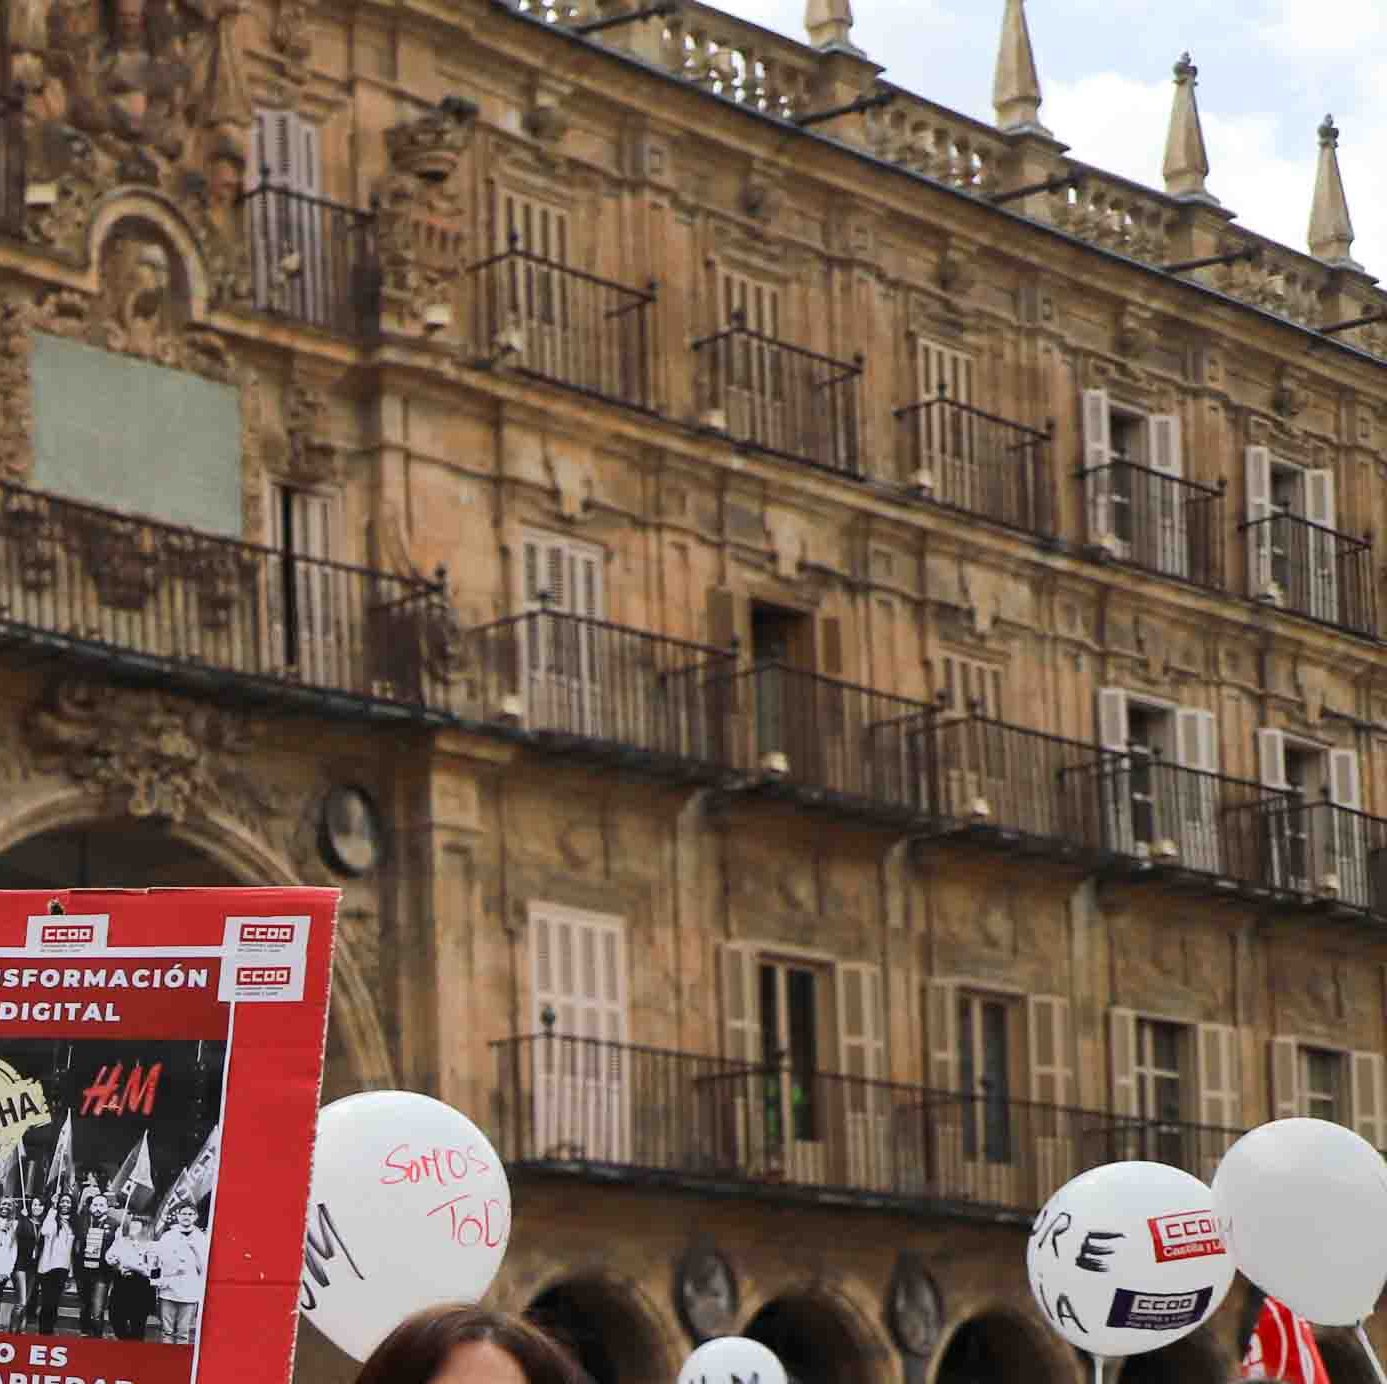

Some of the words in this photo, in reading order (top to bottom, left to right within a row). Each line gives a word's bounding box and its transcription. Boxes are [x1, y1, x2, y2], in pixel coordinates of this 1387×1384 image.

[43, 928, 92, 942] CCOO
[242, 926, 292, 941] CCOO
[238, 969, 289, 984] CCOO
[79, 1061, 162, 1117] H&M
[1138, 1298, 1193, 1312] CCOO
[29, 1345, 69, 1368] ES
